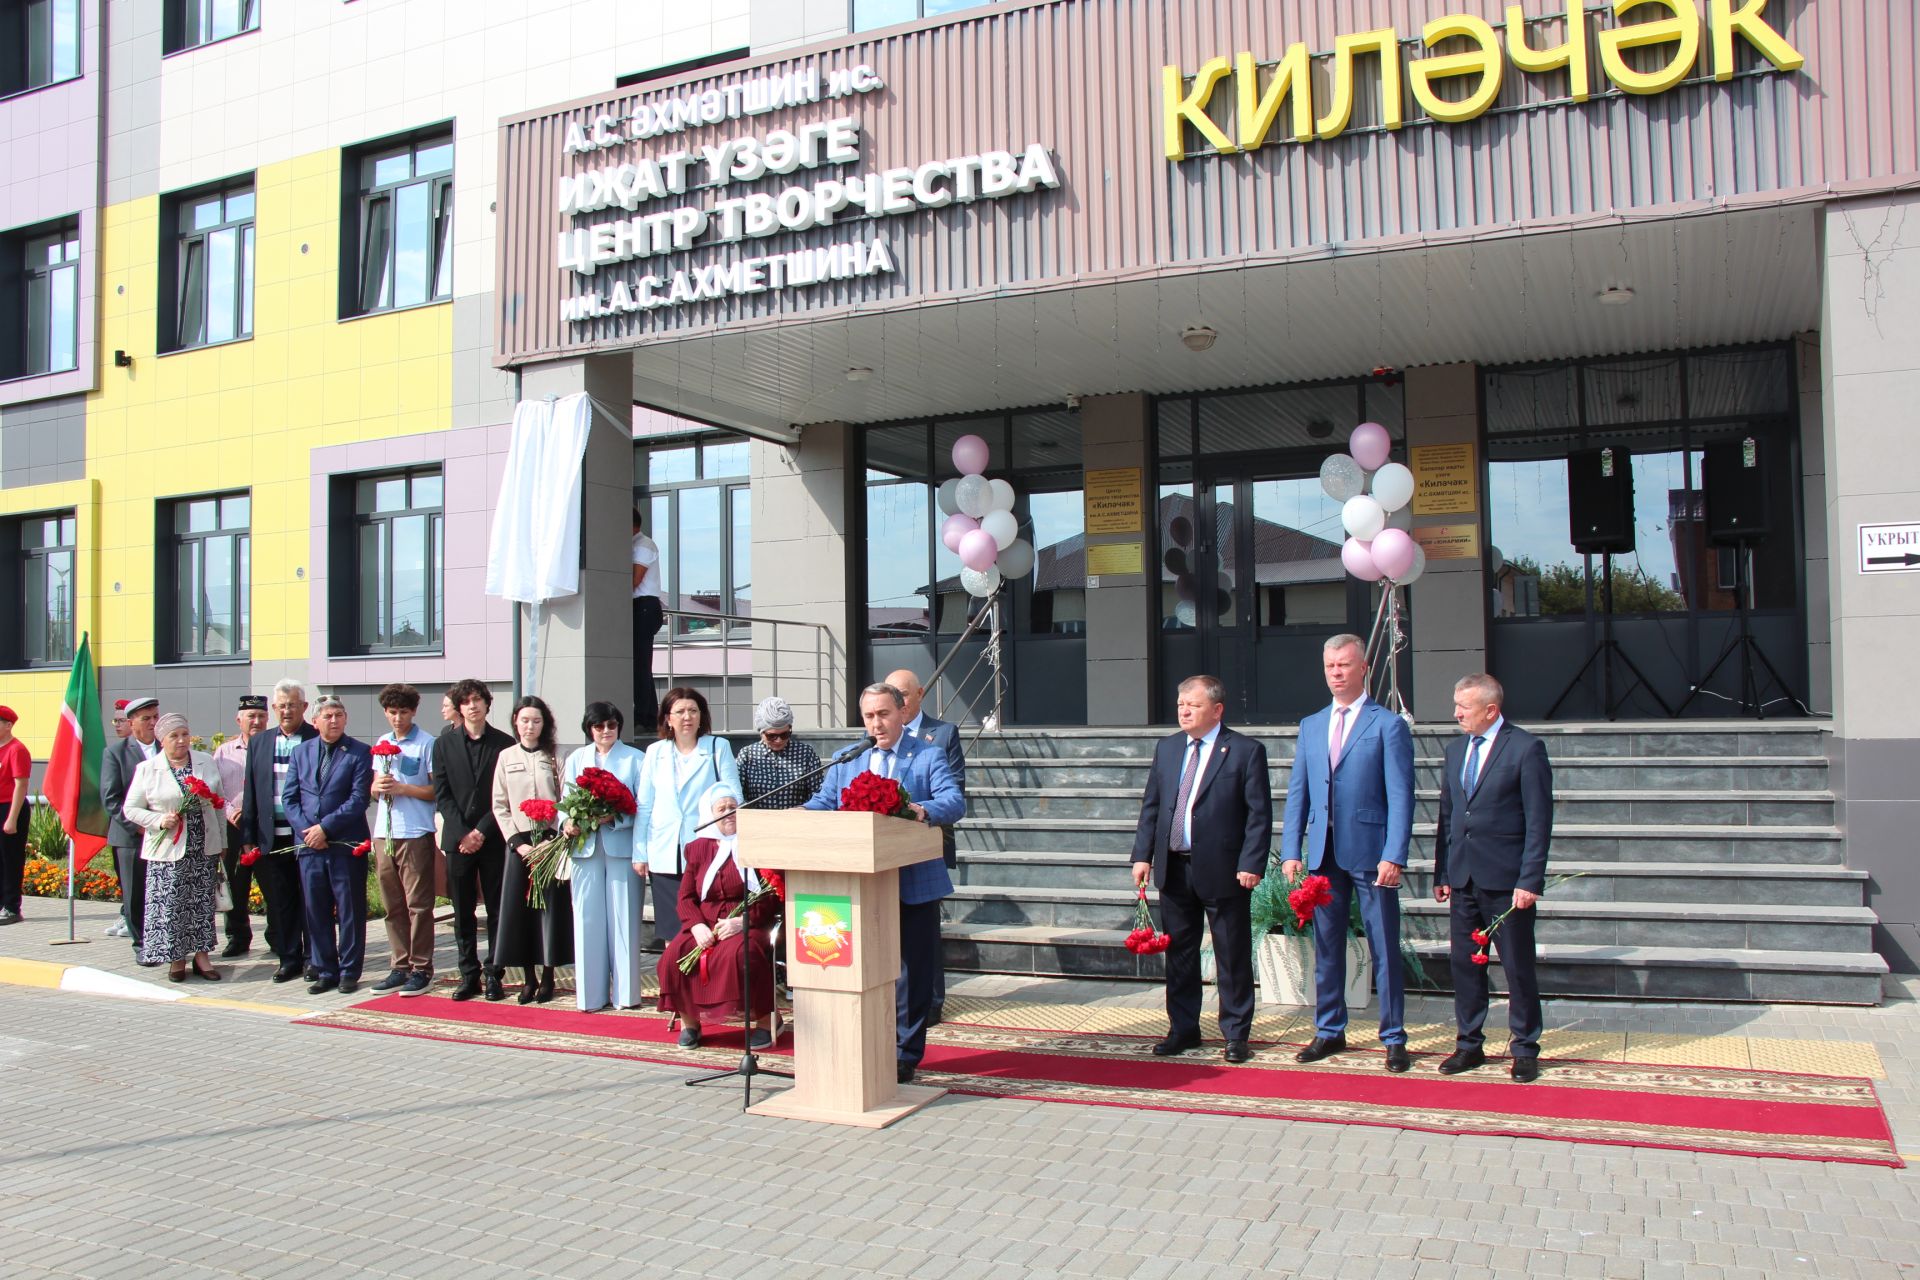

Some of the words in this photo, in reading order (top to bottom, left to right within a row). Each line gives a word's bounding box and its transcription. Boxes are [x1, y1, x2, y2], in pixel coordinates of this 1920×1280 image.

[630, 66, 821, 140] ӘХМӘТШИН
[828, 64, 884, 99] ис.
[1162, 0, 1804, 161] КИЛӘЧӘК
[557, 206, 708, 276] ЦЕНТР
[715, 143, 1061, 241] ТВОРЧЕСТВА
